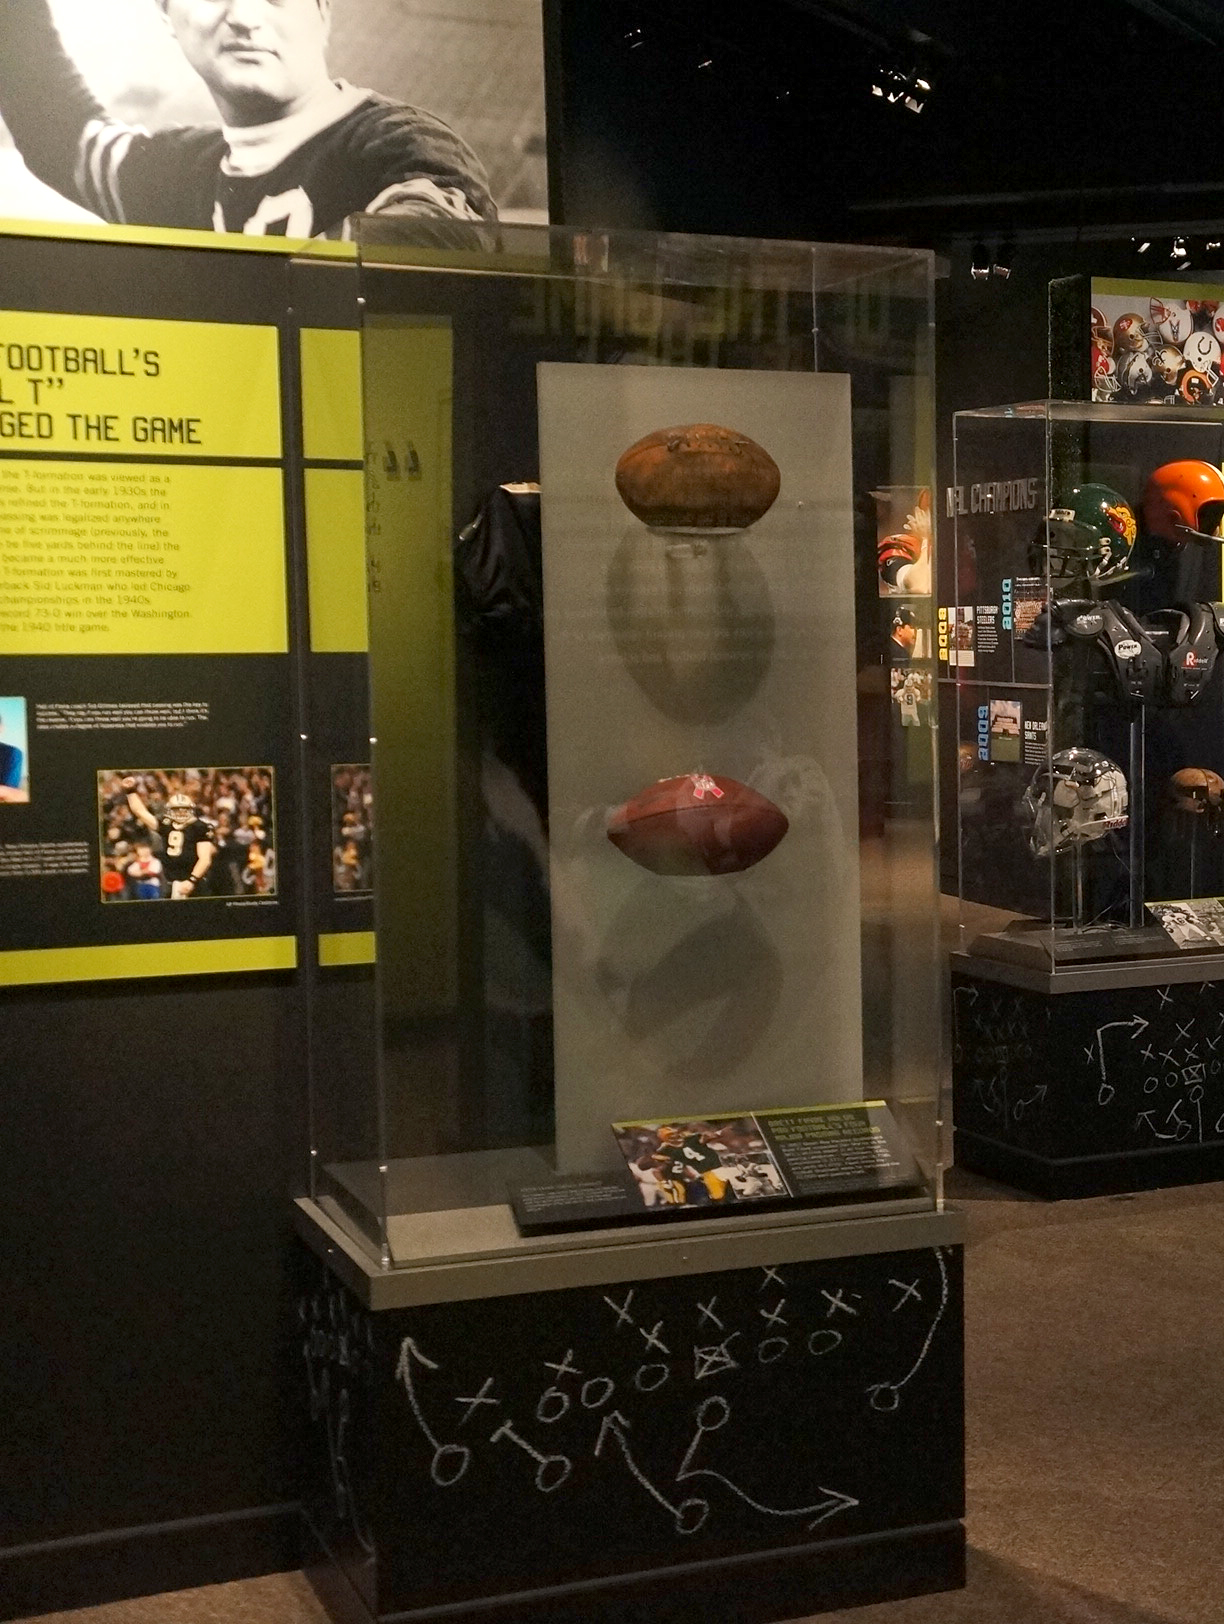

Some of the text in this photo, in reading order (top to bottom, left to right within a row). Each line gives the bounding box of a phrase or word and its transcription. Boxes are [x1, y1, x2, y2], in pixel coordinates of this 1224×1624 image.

[0, 343, 160, 376] OOTBALL'S
[66, 413, 119, 441] THE
[132, 416, 202, 444] GAME
[113, 487, 146, 496] 1930s
[150, 488, 165, 496] the
[971, 478, 1038, 514] CHAMPIONS
[115, 568, 161, 576] mastered
[166, 569, 177, 579] by
[150, 583, 190, 593] Chicago
[131, 610, 190, 620] Washington
[167, 830, 184, 856] 9
